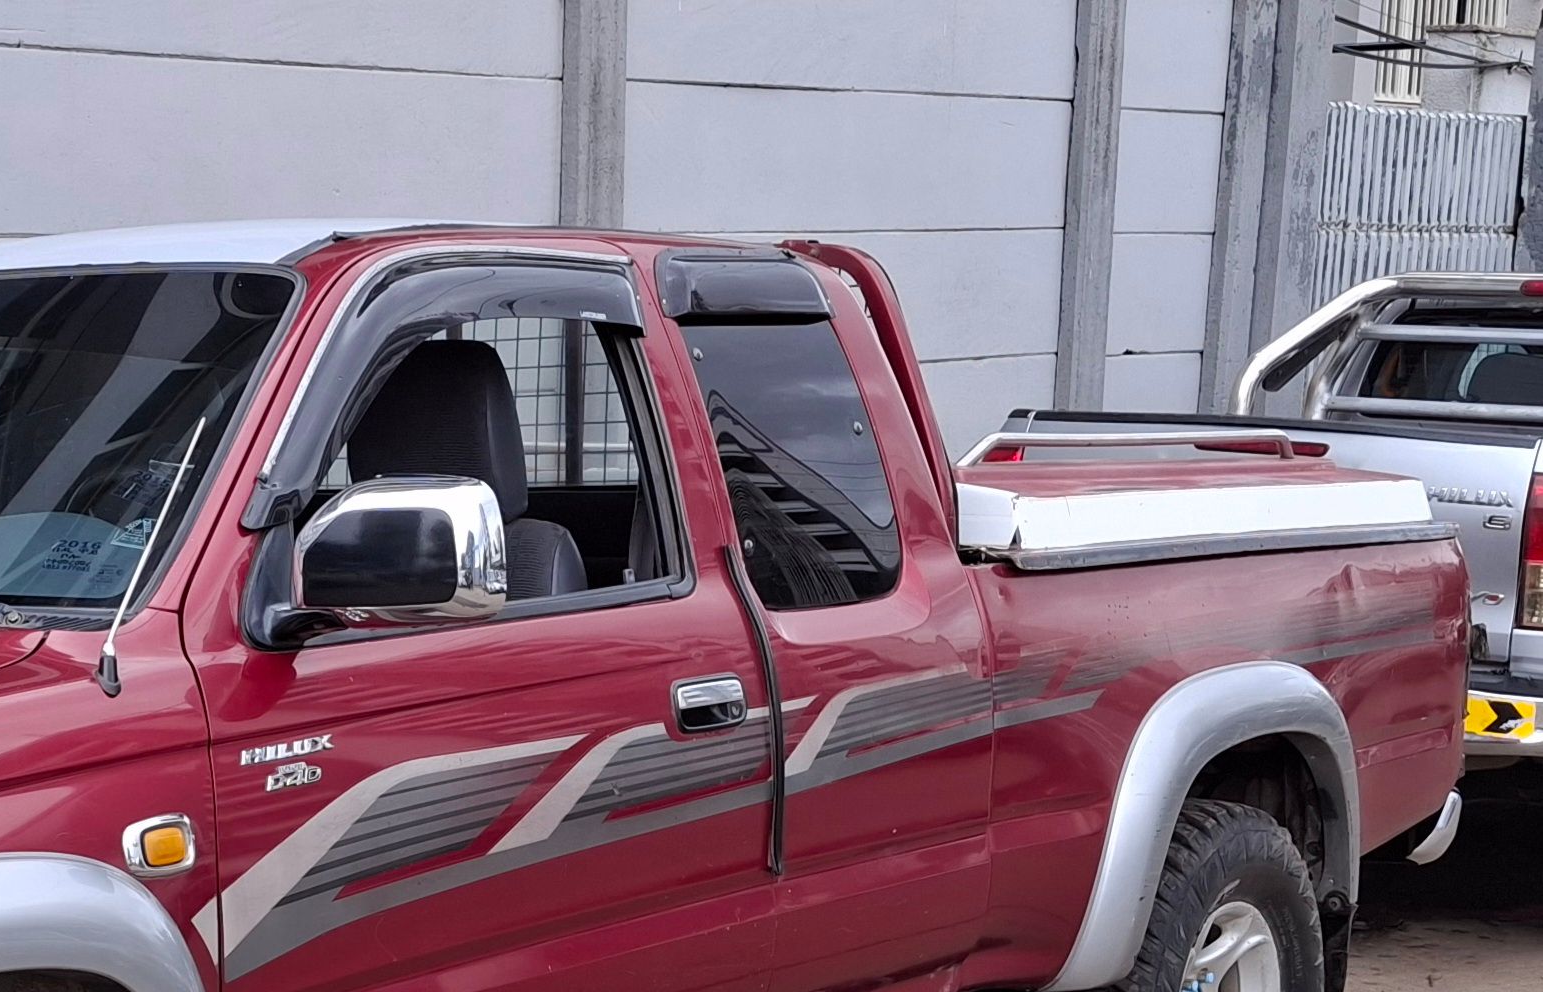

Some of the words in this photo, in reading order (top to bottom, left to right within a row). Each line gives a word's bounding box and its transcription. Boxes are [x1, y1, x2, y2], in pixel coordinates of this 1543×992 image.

[1427, 486, 1513, 508] HILUX
[57, 539, 102, 550] 2016
[240, 734, 334, 766] HILUX
